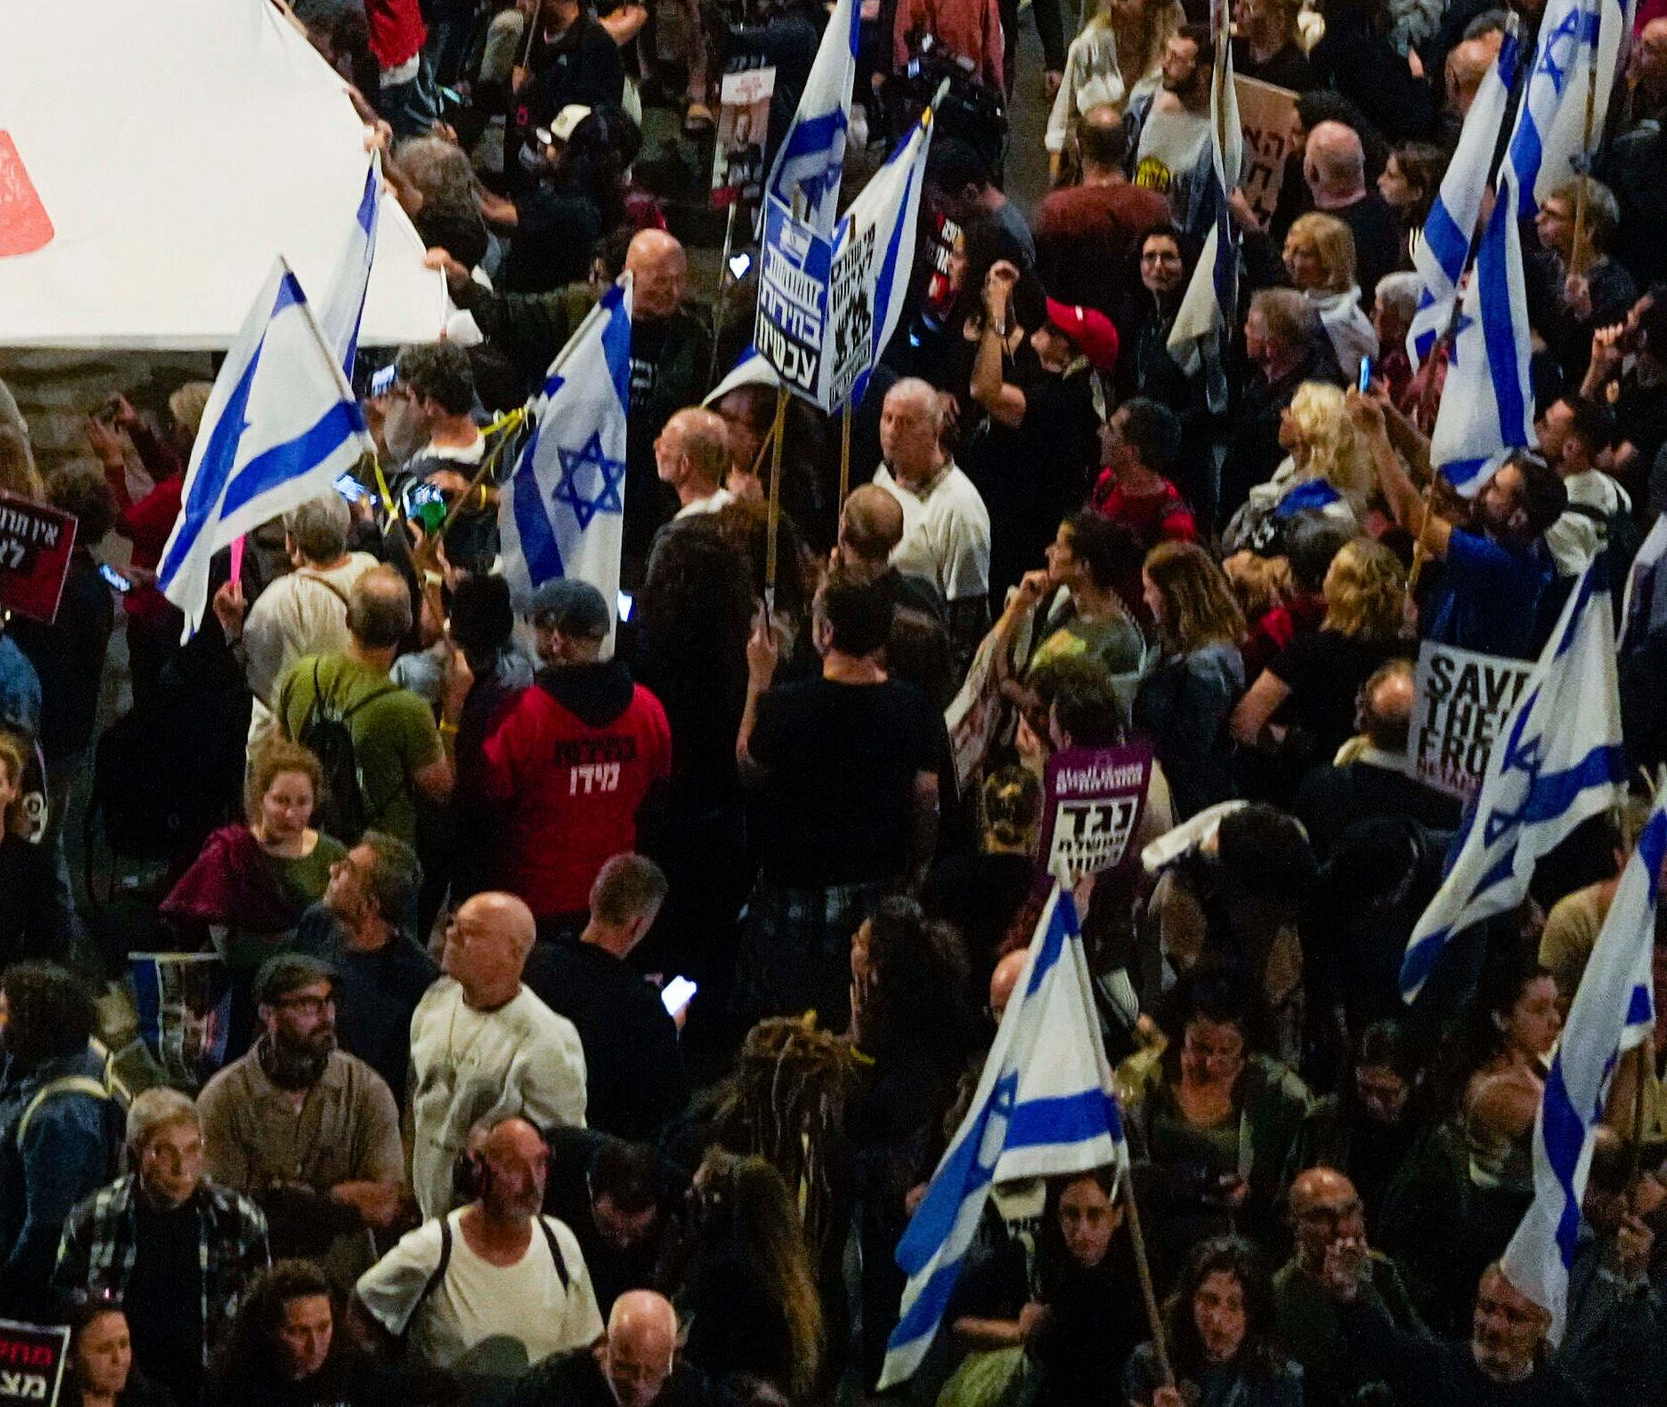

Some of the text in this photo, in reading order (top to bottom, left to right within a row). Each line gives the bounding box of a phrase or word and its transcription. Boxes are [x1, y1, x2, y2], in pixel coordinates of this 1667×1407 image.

[760, 282, 821, 351] בחירות
[1424, 690, 1509, 743] THE
[1418, 727, 1492, 776] FRO
[1063, 803, 1133, 836] נגד
